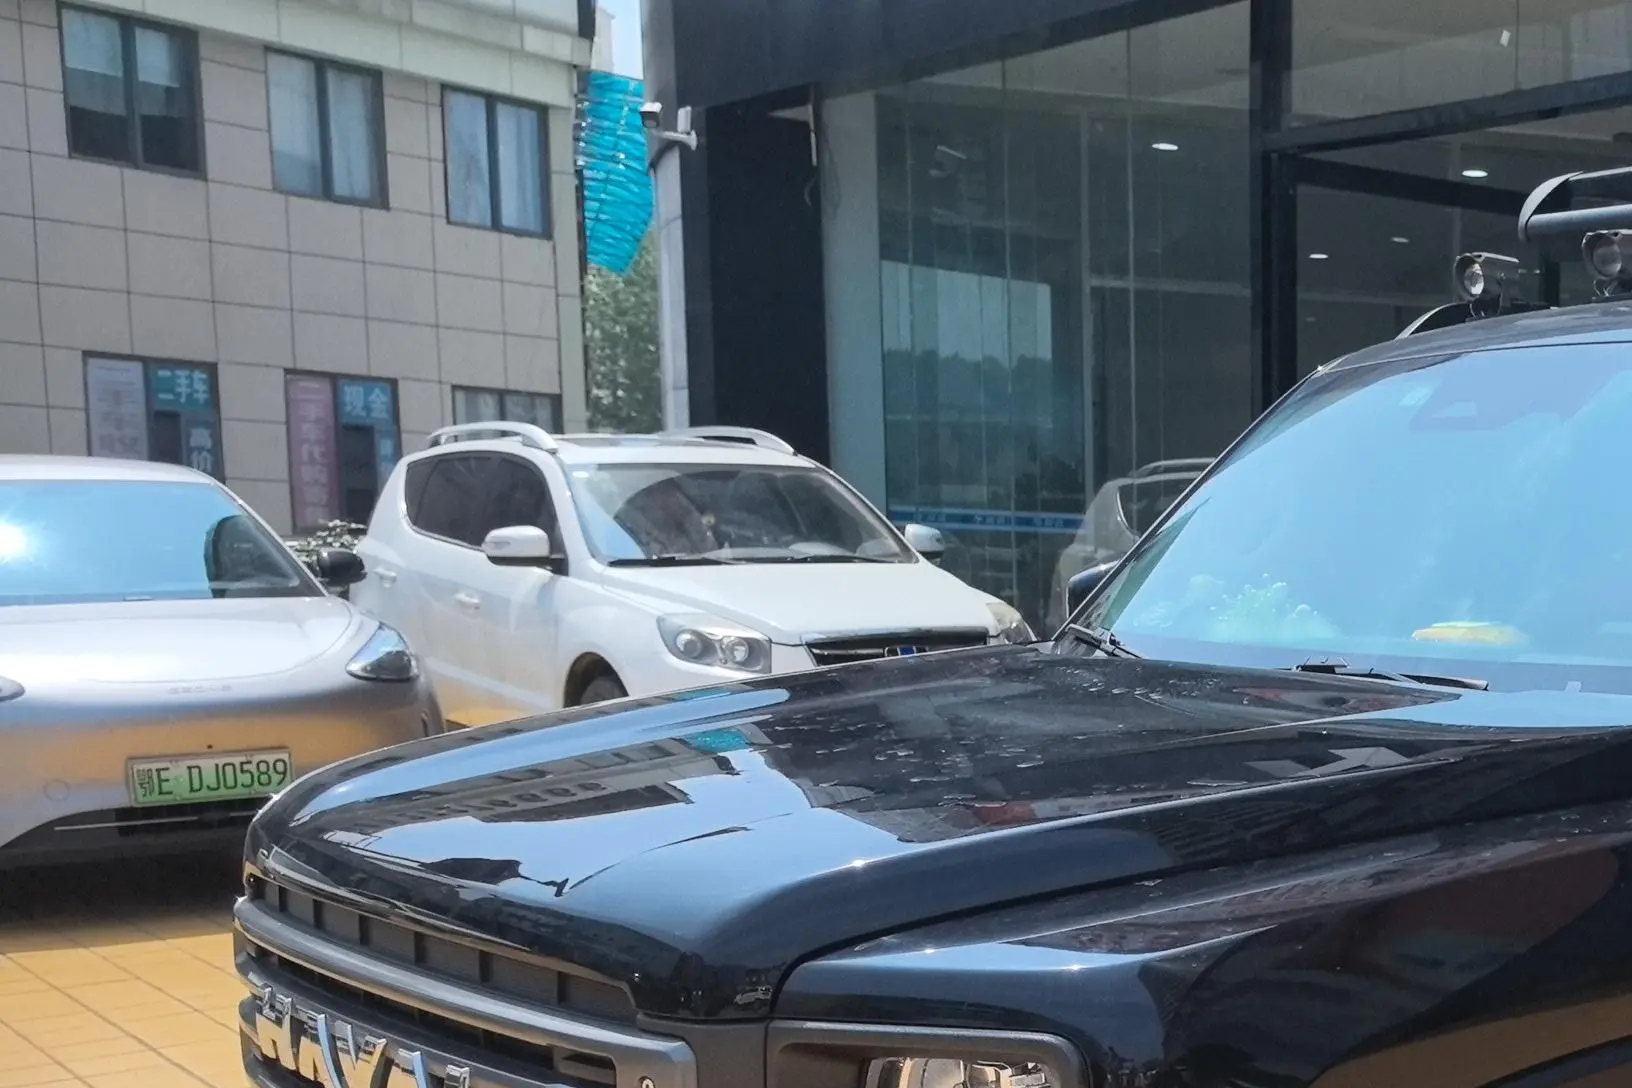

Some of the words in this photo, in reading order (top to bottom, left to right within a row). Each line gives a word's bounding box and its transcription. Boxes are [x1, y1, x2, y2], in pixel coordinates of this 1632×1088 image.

[157, 369, 209, 404] 二手车
[344, 384, 389, 419] 现金
[187, 758, 288, 793] DJ0589
